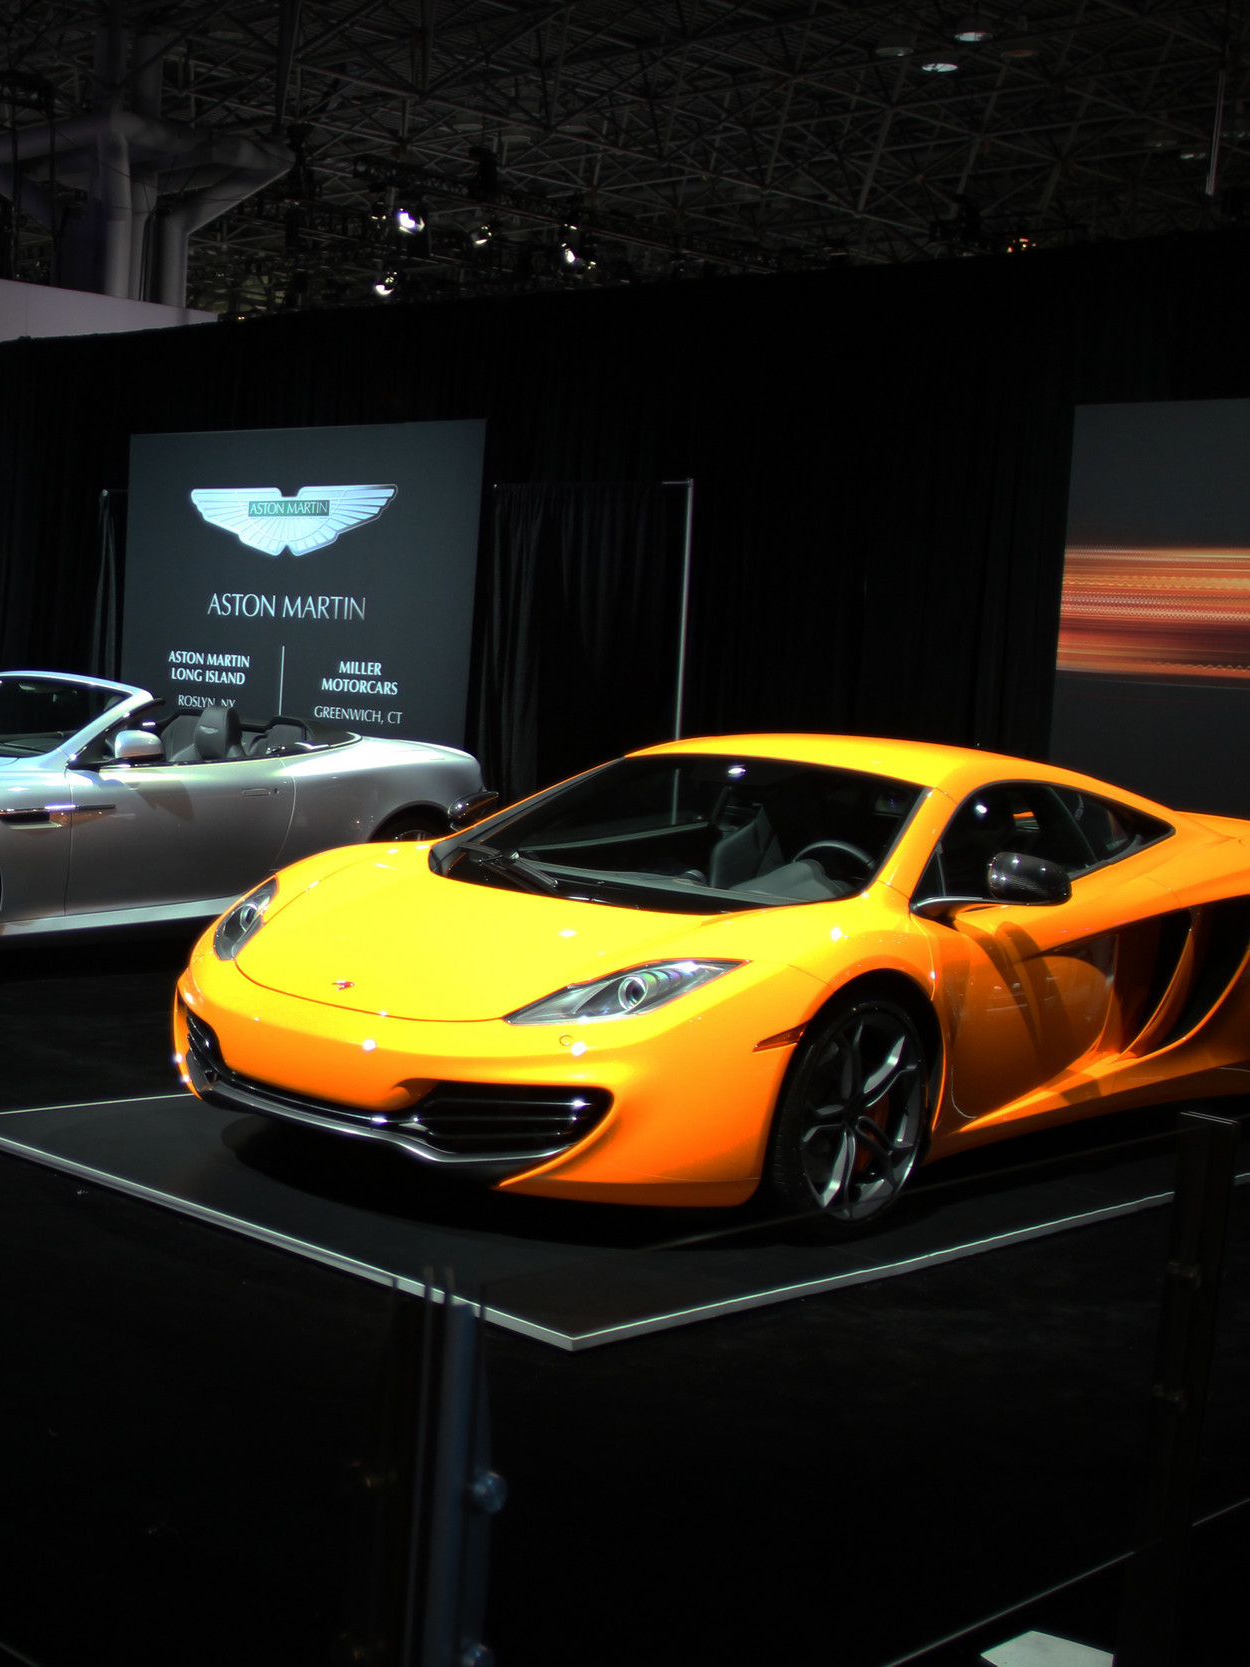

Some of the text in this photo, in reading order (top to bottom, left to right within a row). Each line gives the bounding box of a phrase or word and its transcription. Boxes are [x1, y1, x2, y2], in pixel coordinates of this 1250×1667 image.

[249, 501, 328, 515] ASTON MARTIN
[207, 592, 366, 621] ASTON MARTIN
[168, 650, 250, 668] ASTON MARTIN
[338, 660, 382, 676] MILLER
[171, 667, 246, 685] LONG ISLAND
[321, 677, 399, 696] MOTORCARS
[221, 698, 236, 708] NY
[314, 705, 403, 725] GREENWICH, CT
